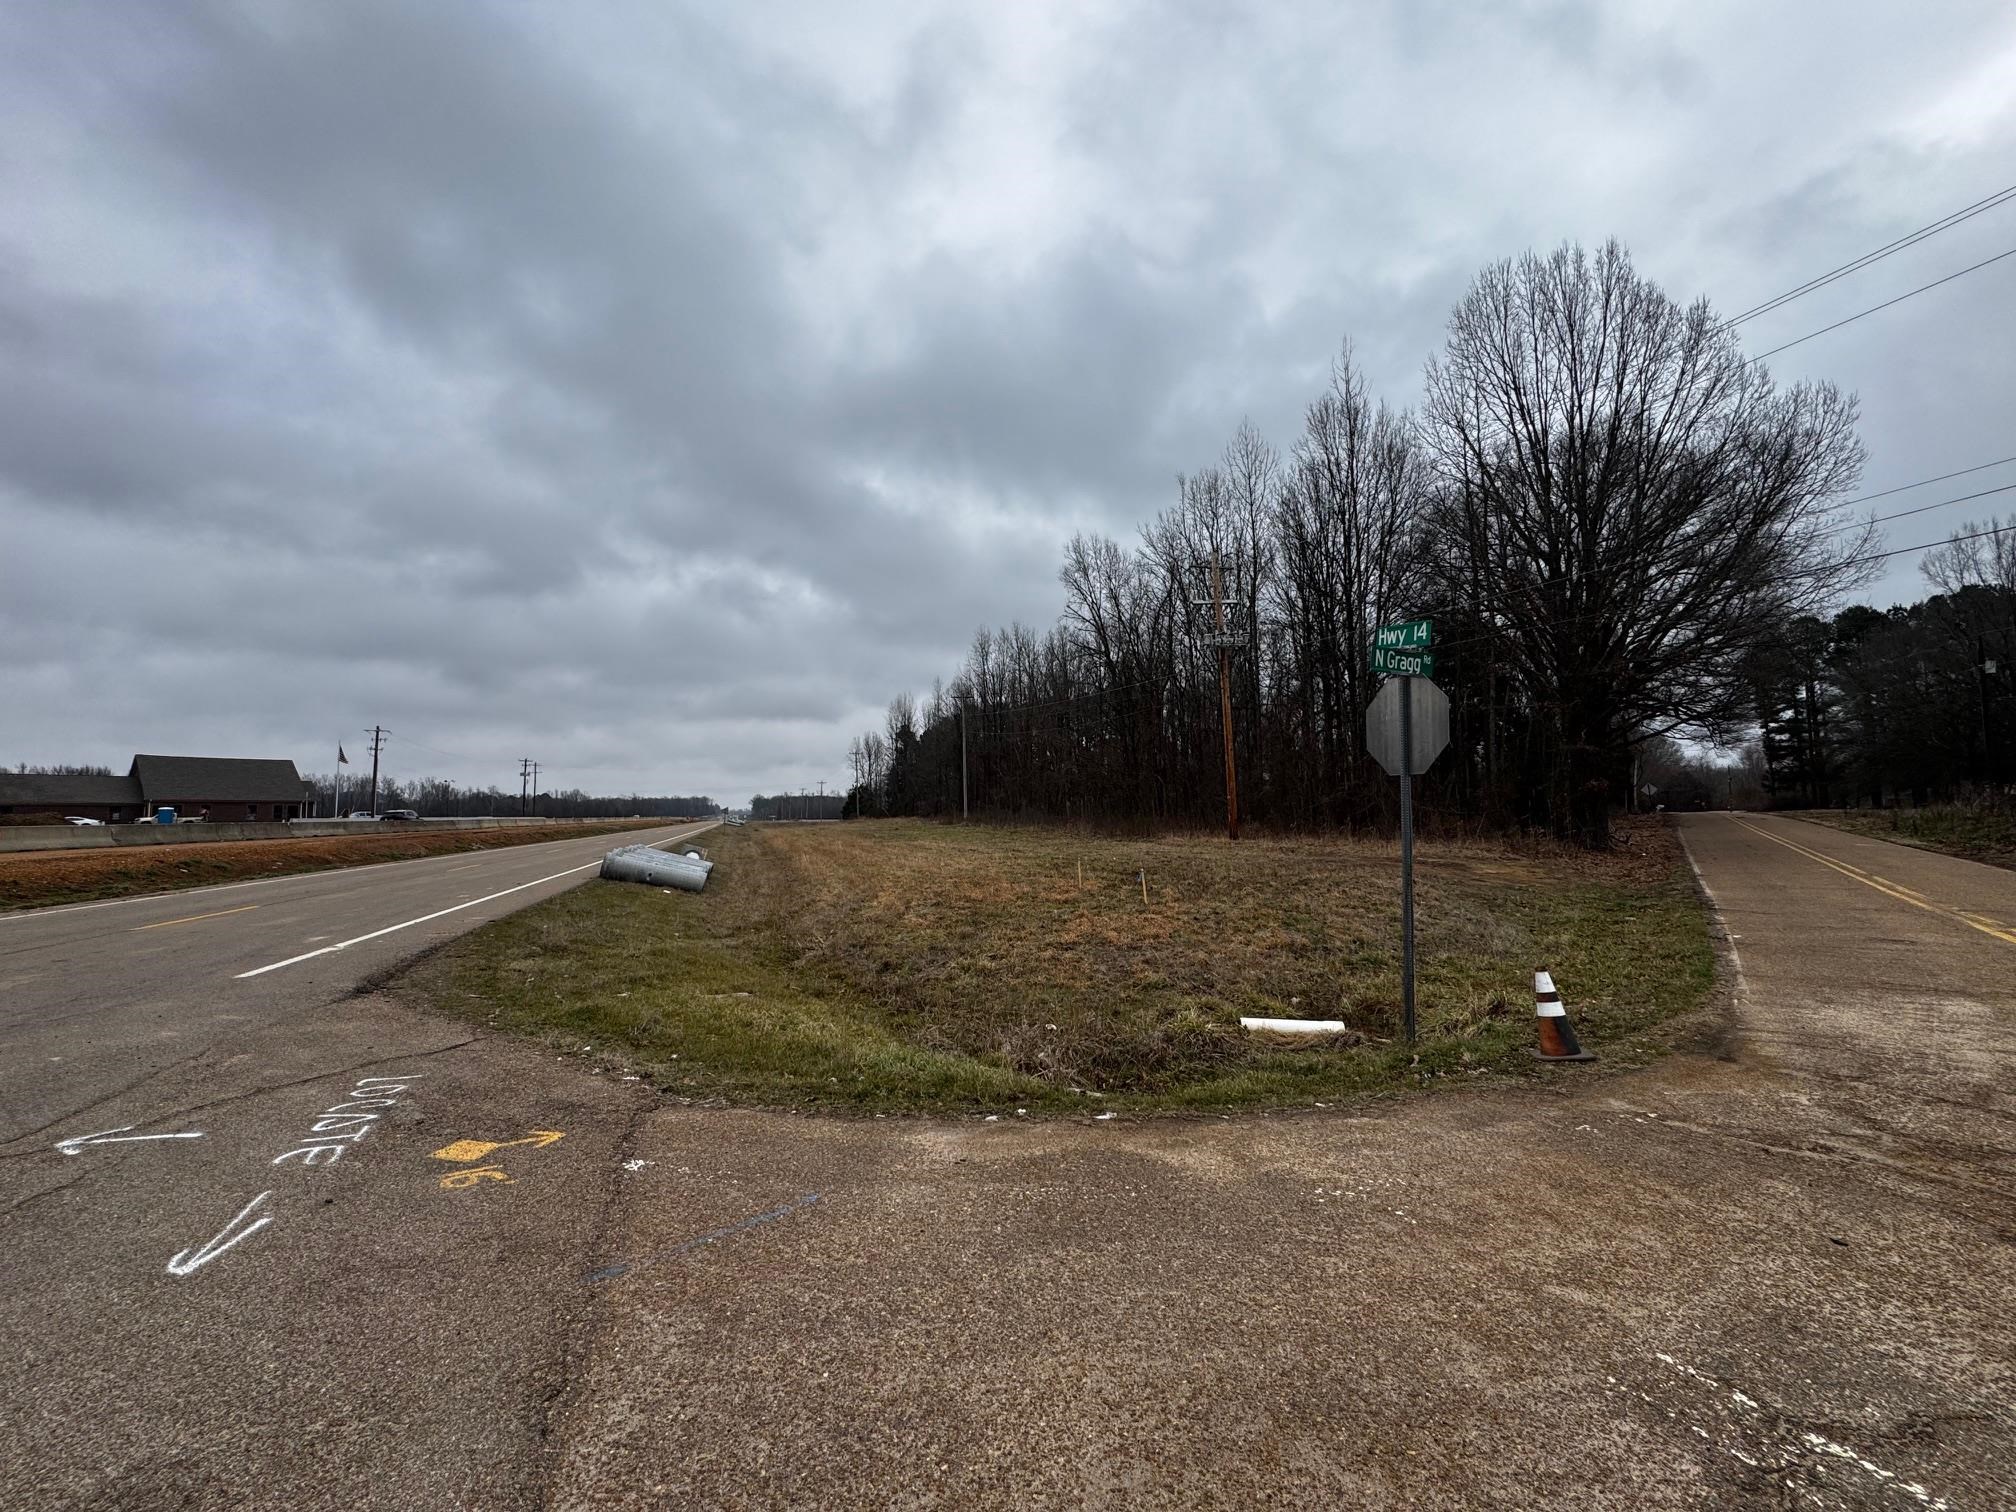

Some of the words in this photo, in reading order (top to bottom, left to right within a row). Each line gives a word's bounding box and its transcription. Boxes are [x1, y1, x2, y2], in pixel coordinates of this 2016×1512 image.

[1378, 628, 1407, 648] Hwy
[1413, 622, 1427, 641] 14
[1375, 649, 1384, 667] N
[1387, 651, 1422, 674] Gragg
[1423, 655, 1431, 664] Rd
[272, 1074, 424, 1165] LOCATE
